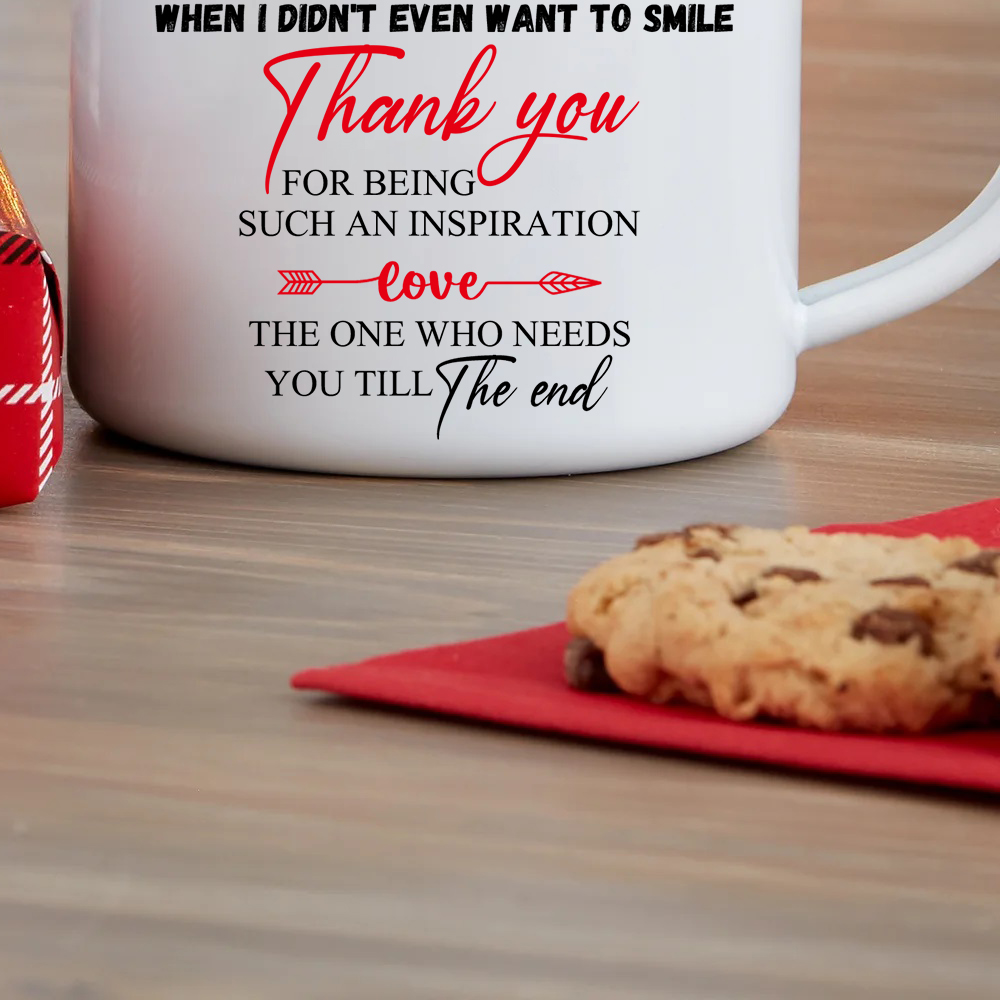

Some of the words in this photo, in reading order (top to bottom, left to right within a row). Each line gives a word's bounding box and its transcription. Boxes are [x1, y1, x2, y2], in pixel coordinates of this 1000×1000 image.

[154, 3, 246, 33] WHEN
[257, 3, 268, 33] I
[277, 3, 377, 33] DIDN'T
[389, 3, 474, 33] EVEN
[485, 3, 578, 33] WANT
[589, 3, 632, 33] TO
[642, 3, 735, 33] SMILE
[262, 43, 500, 195] Thank
[476, 91, 640, 187] you
[281, 169, 355, 197] FOR
[362, 169, 476, 197] BEING
[238, 209, 336, 237] SUCH
[345, 210, 398, 237] AN
[408, 209, 640, 237] INSPIRATION
[376, 260, 489, 303] love
[248, 320, 320, 347] THE
[330, 320, 405, 348] ONE
[414, 320, 503, 348] WHO
[511, 320, 631, 348] NEEDS
[264, 369, 344, 397] YOU
[354, 370, 434, 397] TILL
[435, 354, 518, 441] The
[530, 354, 613, 412] end
